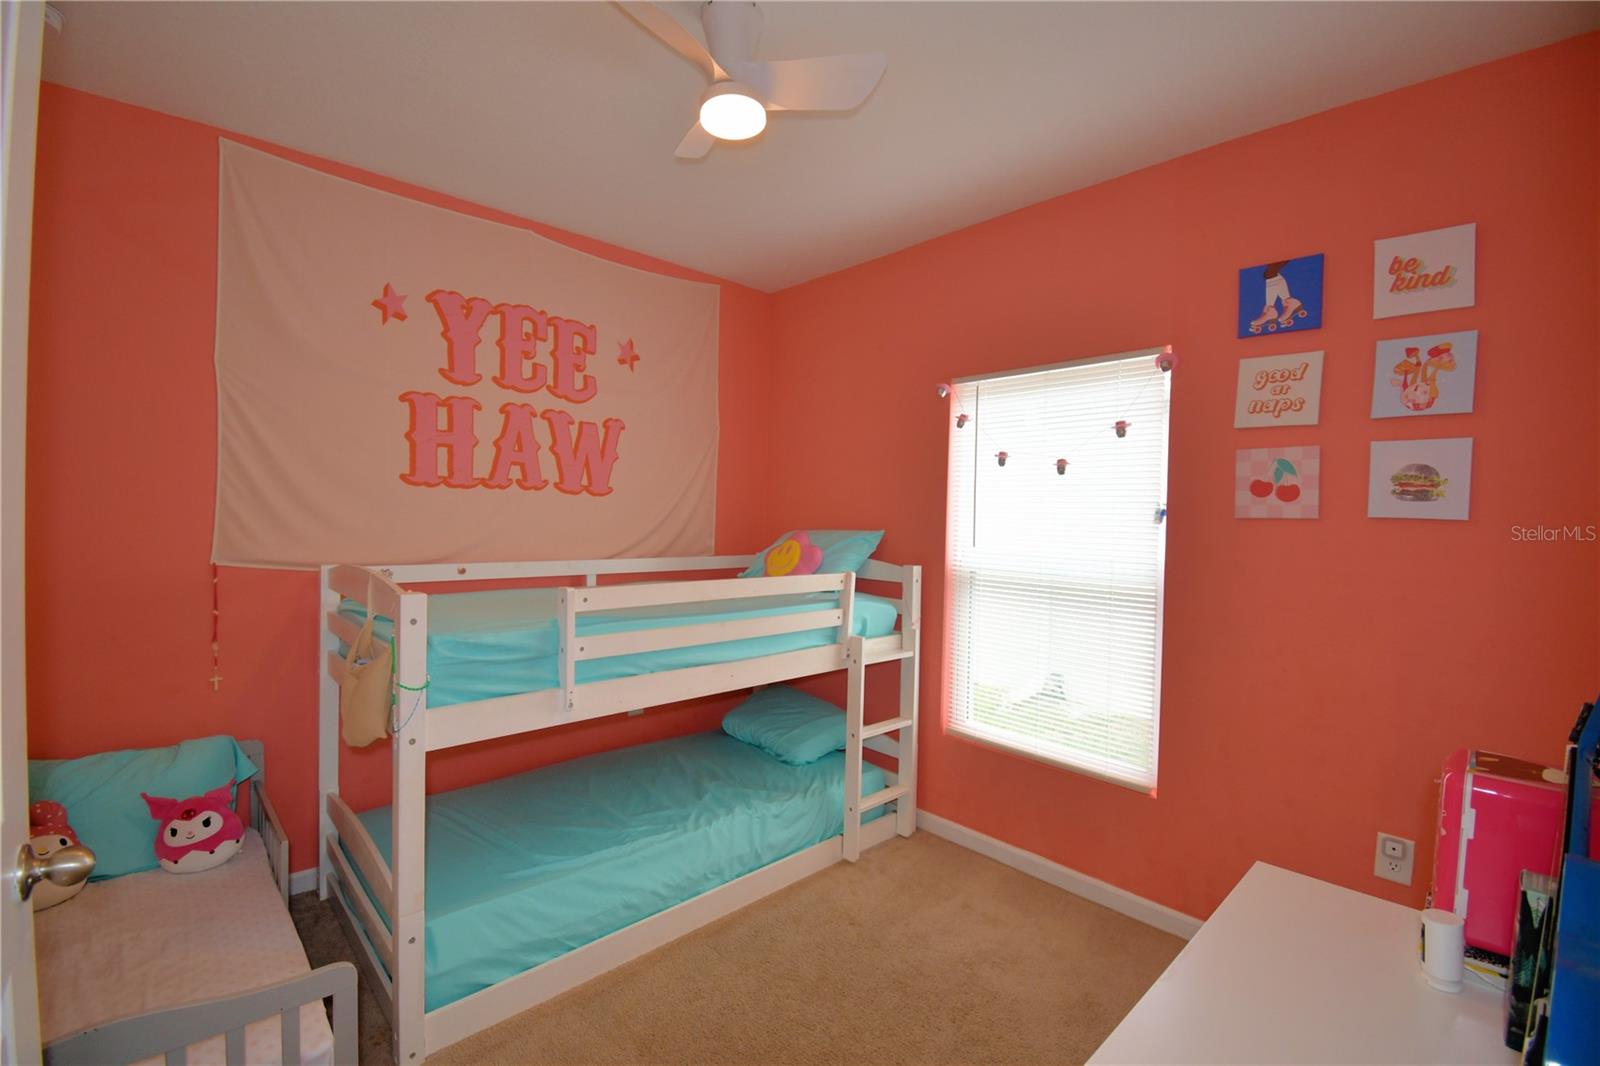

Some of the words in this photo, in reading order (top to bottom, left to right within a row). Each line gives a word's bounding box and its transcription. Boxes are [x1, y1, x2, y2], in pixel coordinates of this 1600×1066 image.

[1388, 255, 1421, 276] be
[1389, 265, 1456, 293] kind
[425, 289, 597, 404] YEE
[1253, 362, 1309, 391] good
[1270, 383, 1291, 396] at
[1247, 397, 1305, 418] naps
[398, 391, 626, 497] HAW
